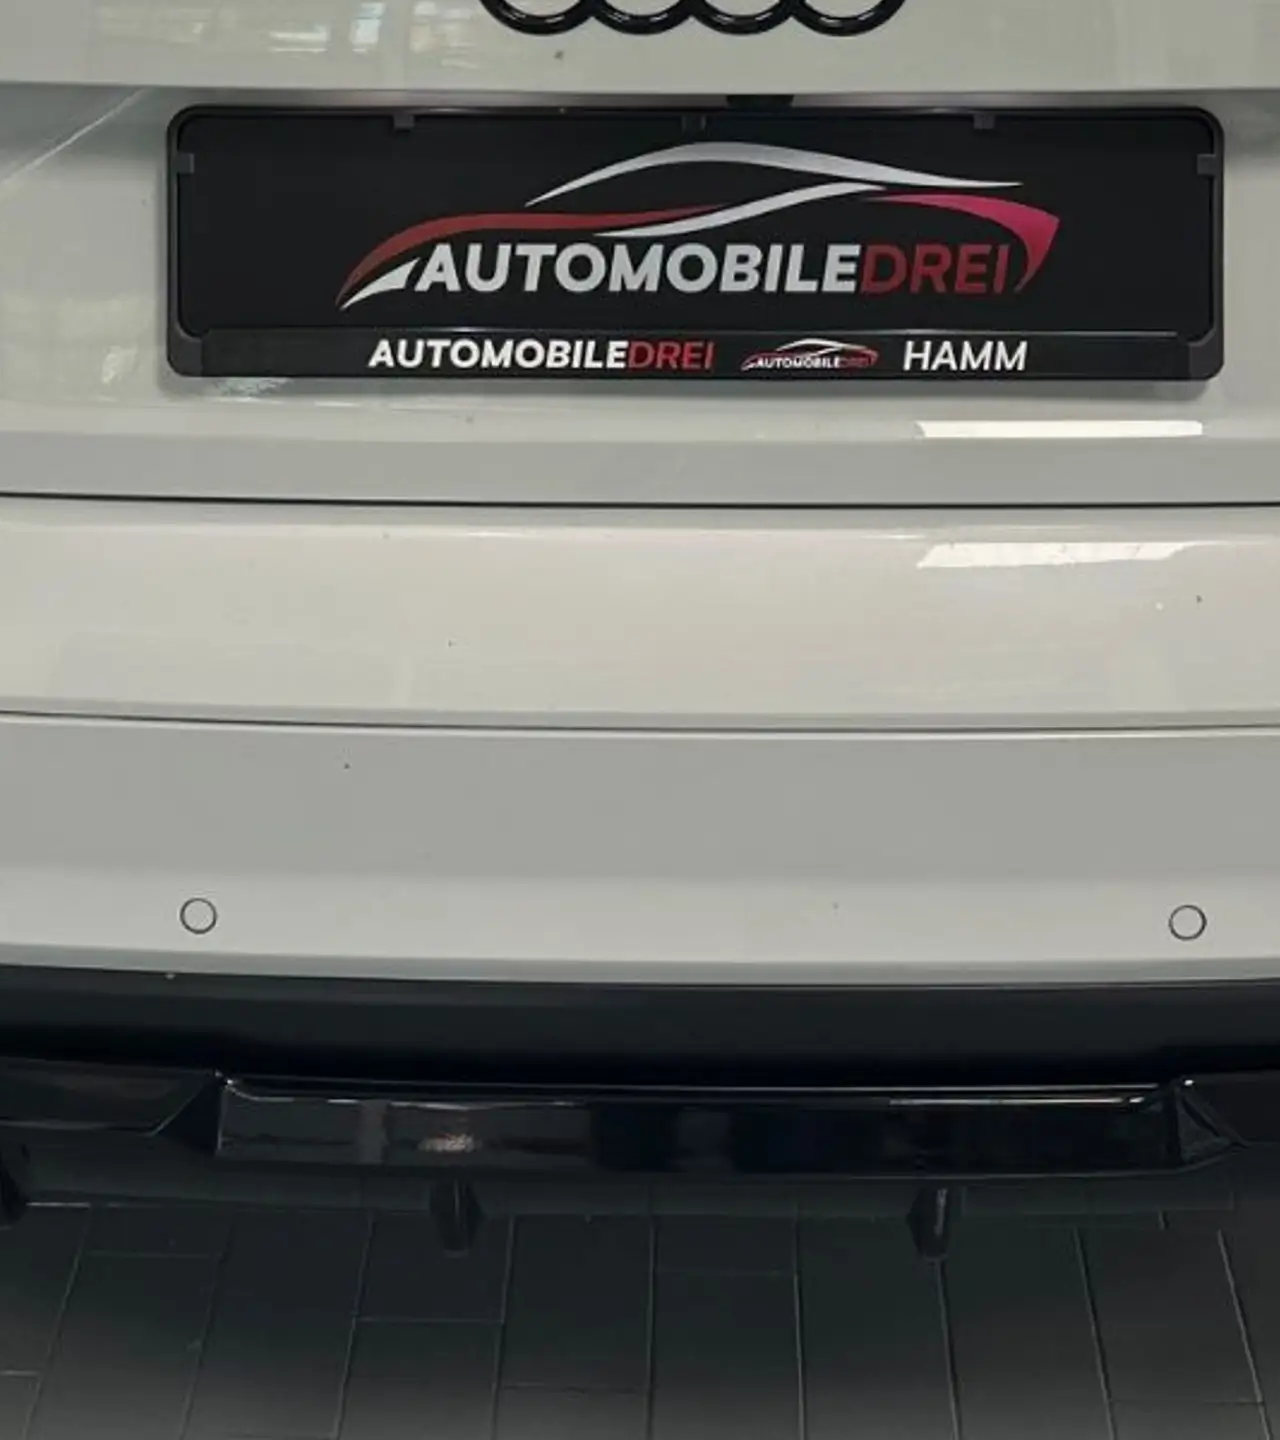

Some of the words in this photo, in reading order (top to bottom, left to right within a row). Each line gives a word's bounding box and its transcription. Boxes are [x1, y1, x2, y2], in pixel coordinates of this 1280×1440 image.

[414, 243, 1010, 293] AUTOMOBILEDREI
[368, 339, 715, 369] AUTOMOBILEDREI
[903, 341, 1028, 371] HAMM
